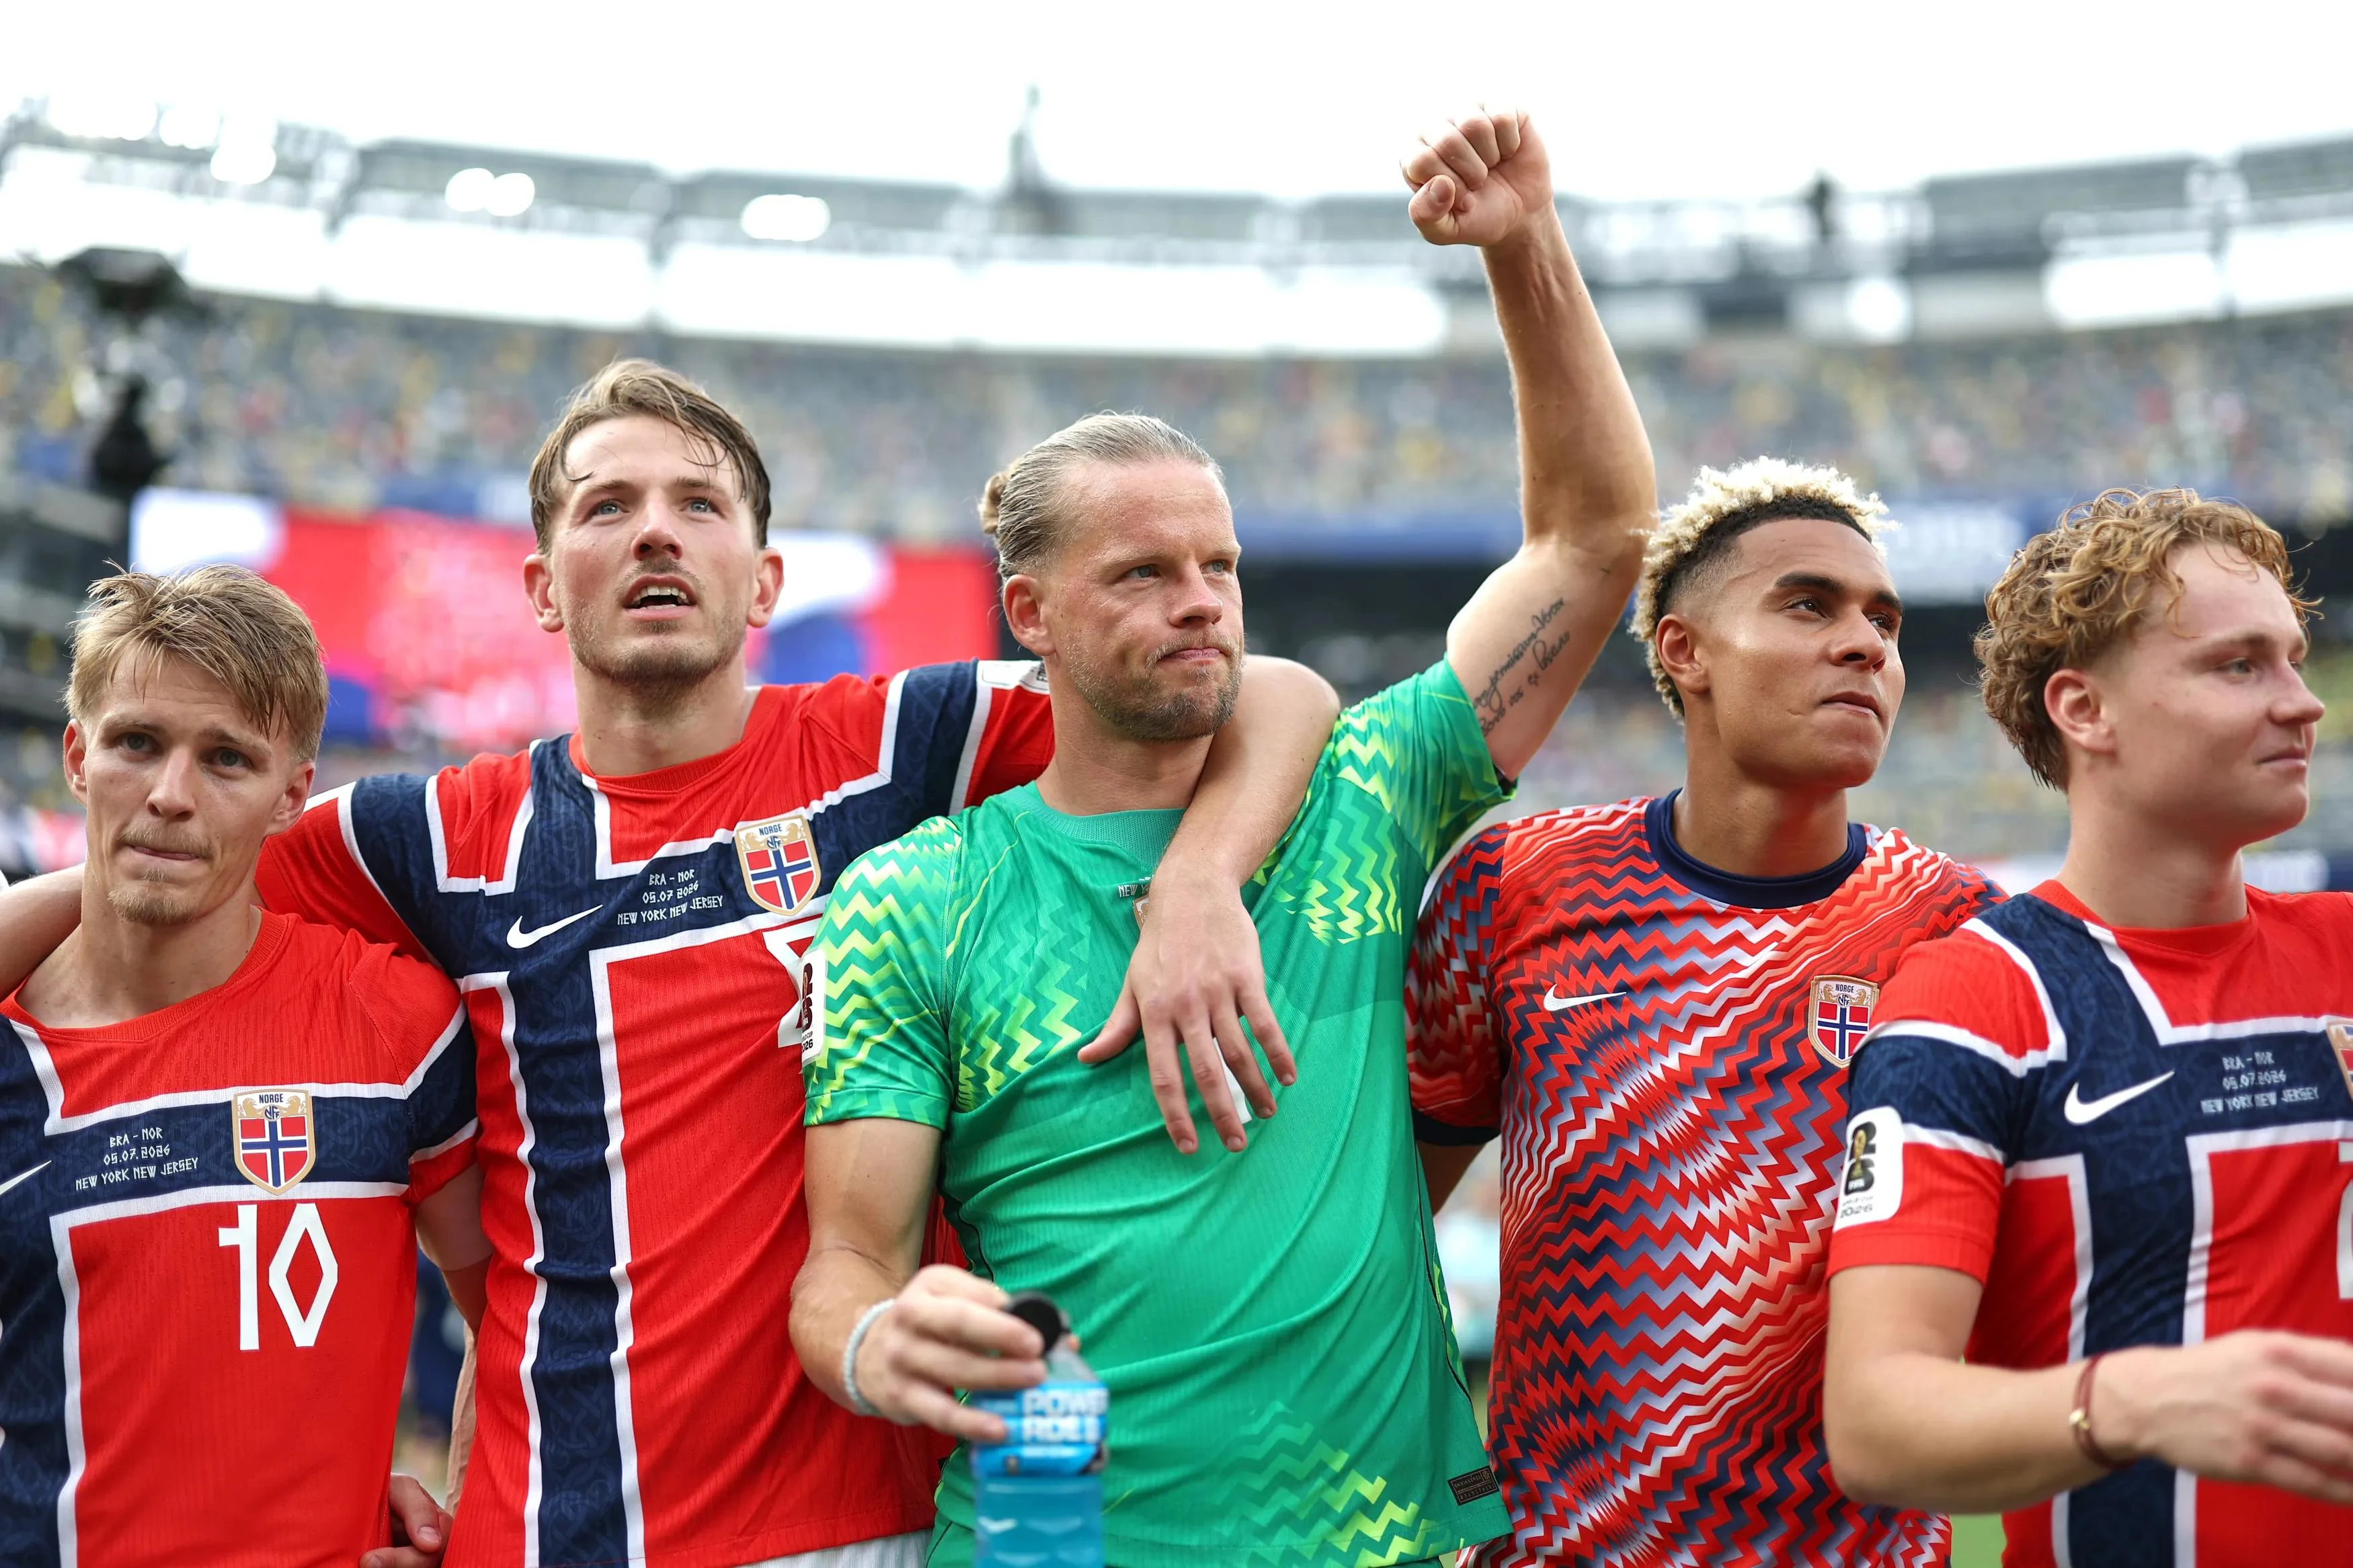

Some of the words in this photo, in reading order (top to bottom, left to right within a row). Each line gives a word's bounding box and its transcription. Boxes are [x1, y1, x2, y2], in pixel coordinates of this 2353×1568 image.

[759, 823, 782, 835] NORGE
[649, 873, 666, 886] BRA
[678, 869, 694, 883] NOR
[643, 880, 699, 904] 05.072026
[1118, 884, 1138, 897] NEW
[617, 912, 637, 925] NEW
[641, 908, 667, 923] YORK
[670, 902, 688, 917] NEW
[690, 895, 723, 909] JERSEY
[1835, 984, 1855, 993] NORGE
[802, 1039, 813, 1053] 026
[259, 1094, 284, 1104] NORGE
[2225, 1094, 2254, 1111] YORK
[2281, 1087, 2319, 1102] JERSEY
[110, 1134, 130, 1148] BRA
[142, 1127, 163, 1141] NOR
[104, 1144, 170, 1165] 05.07.2026
[76, 1175, 97, 1190] NEW
[102, 1168, 130, 1184] YORK
[134, 1165, 156, 1180] NEW
[160, 1157, 198, 1175] JERSEY
[218, 1203, 337, 1350] 10
